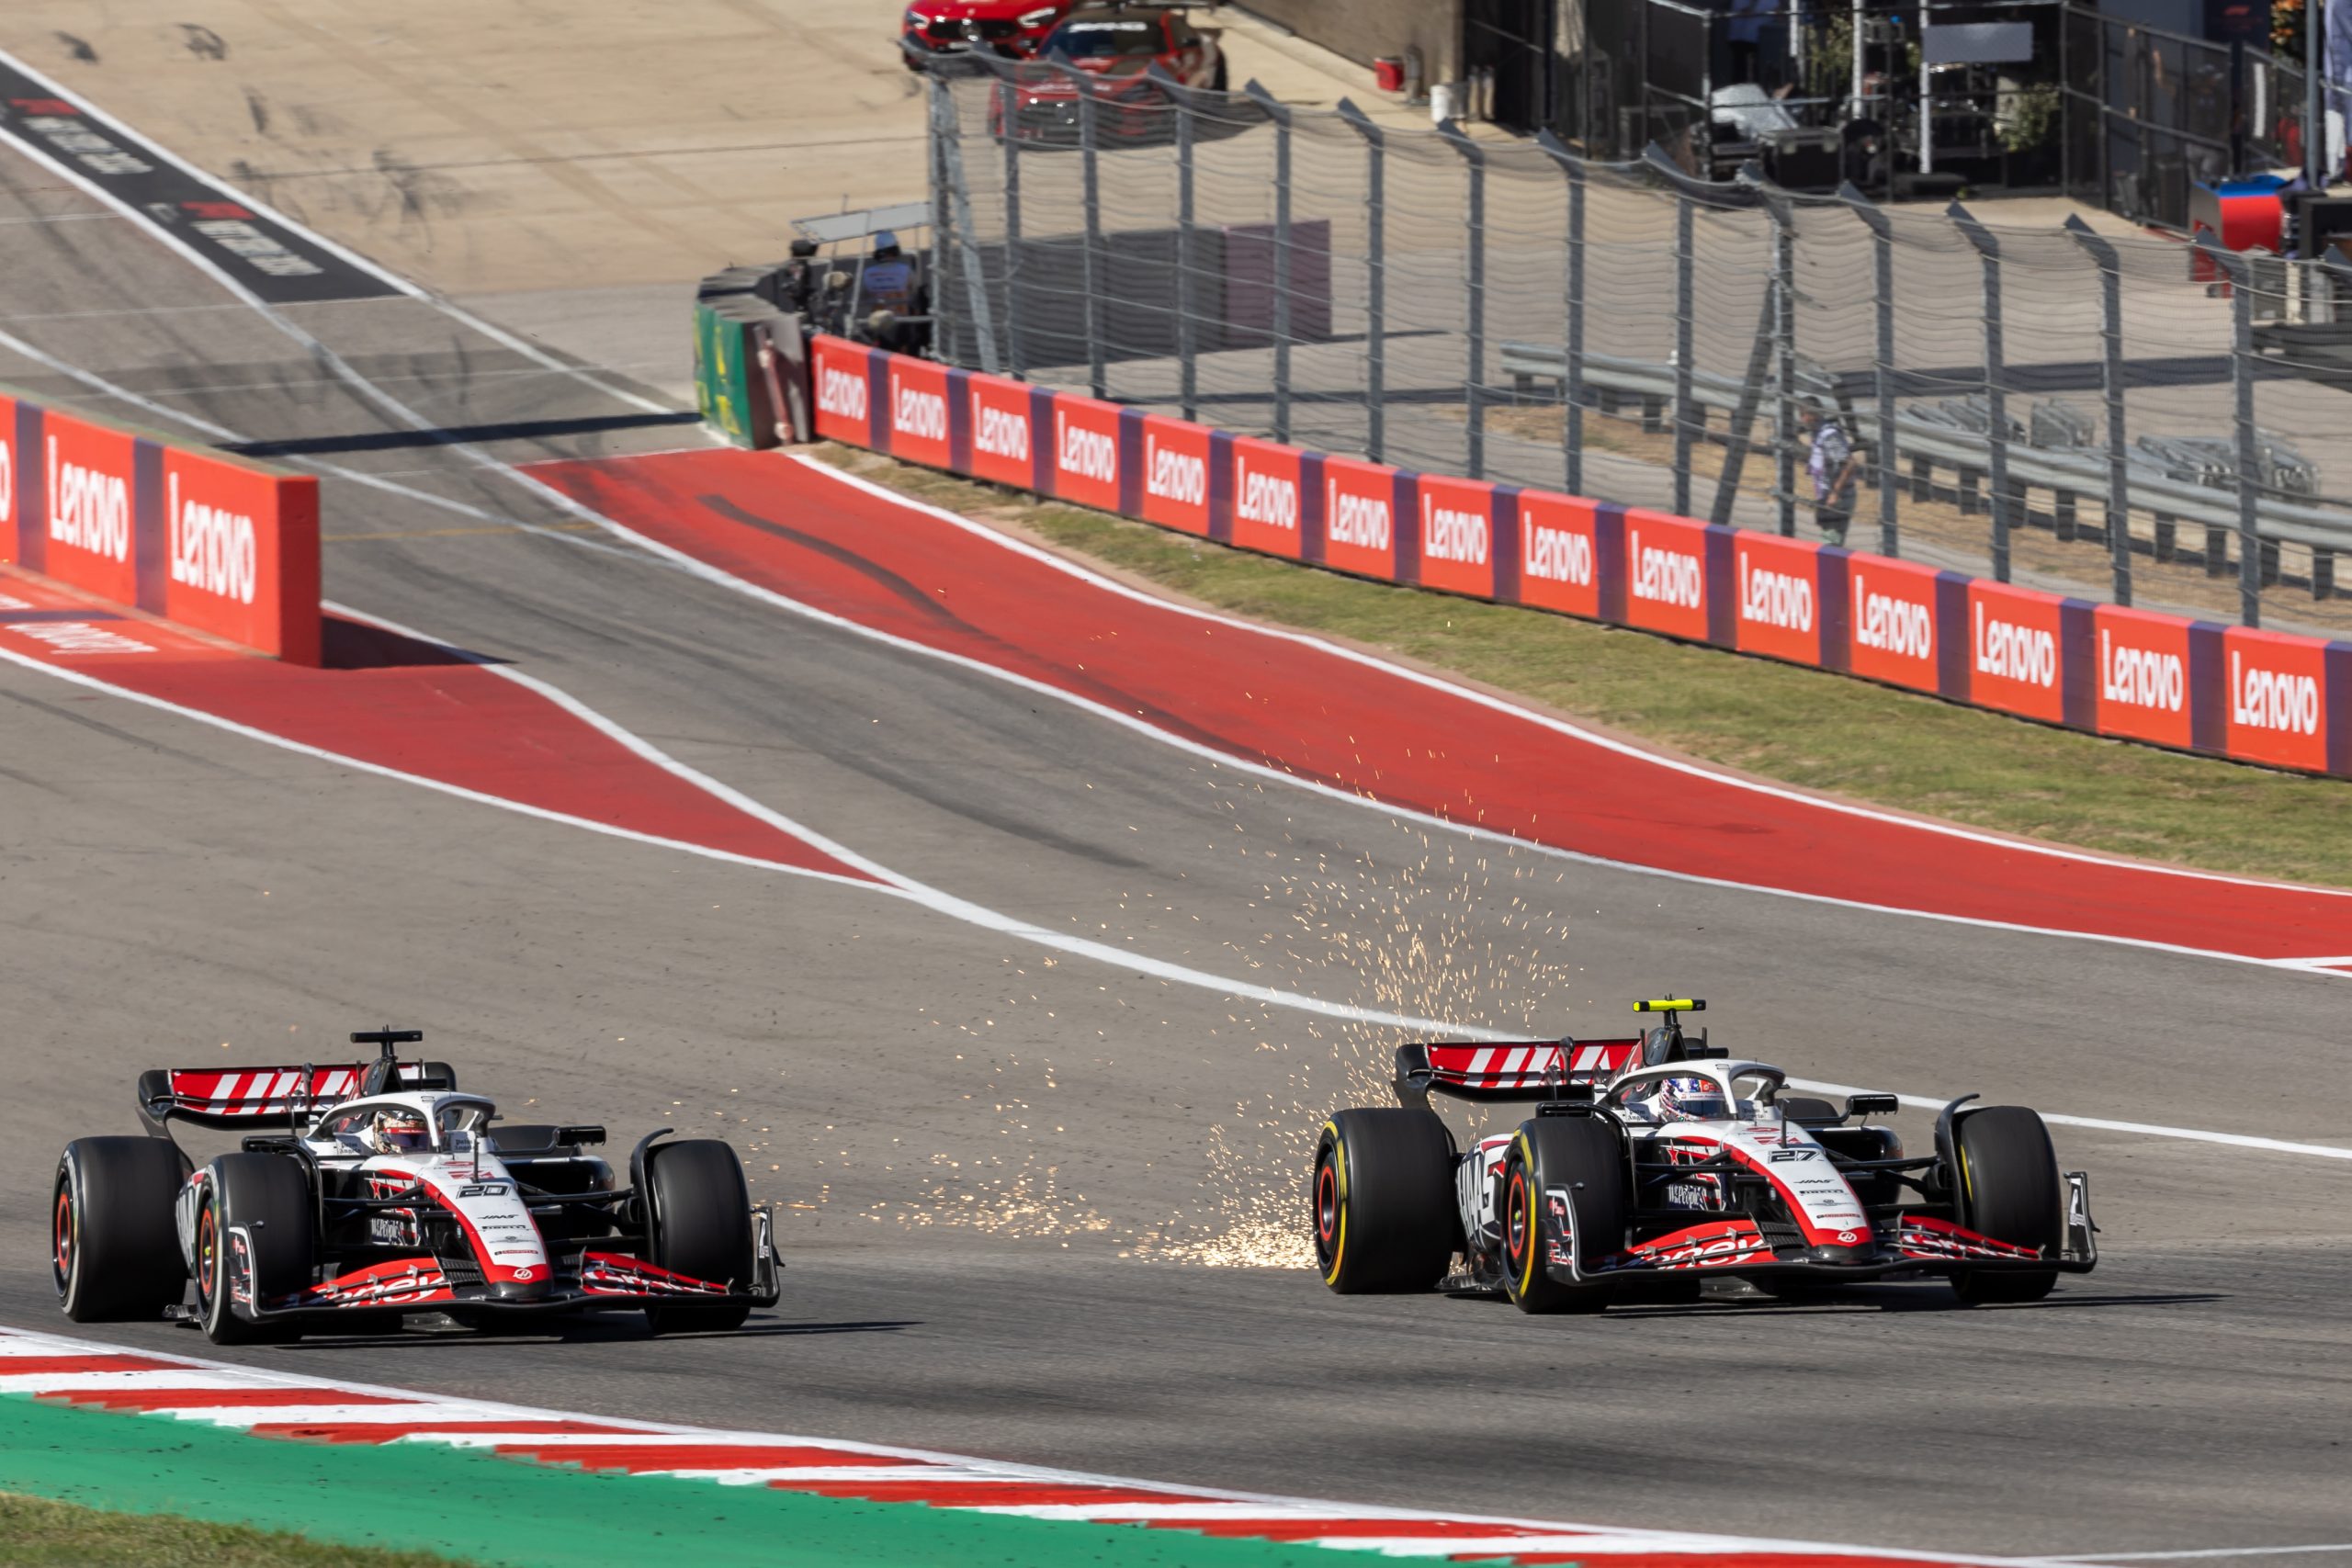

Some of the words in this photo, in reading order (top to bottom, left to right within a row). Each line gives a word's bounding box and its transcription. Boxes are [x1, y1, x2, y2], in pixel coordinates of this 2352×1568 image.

[818, 354, 867, 421] Lenovo
[892, 374, 946, 442] Lenovo
[973, 391, 1029, 462] Lenovo
[1058, 410, 1116, 483] Lenovo
[48, 434, 130, 563] Lenovo
[1147, 434, 1206, 506] Lenovo
[1237, 456, 1297, 530] Lenovo
[169, 471, 256, 605] Lenovo
[1329, 478, 1390, 551] Lenovo
[1424, 492, 1488, 566] Lenovo
[1523, 511, 1592, 588] Lenovo
[1631, 530, 1702, 609] Lenovo
[1740, 551, 1813, 633] Lenovo
[1855, 574, 1932, 660] Lenovo
[1975, 601, 2056, 688] Lenovo
[2102, 628, 2184, 713] Lenovo
[2232, 650, 2319, 736] Lenovo
[458, 1185, 510, 1199] 20
[1770, 1150, 1820, 1163] 27
